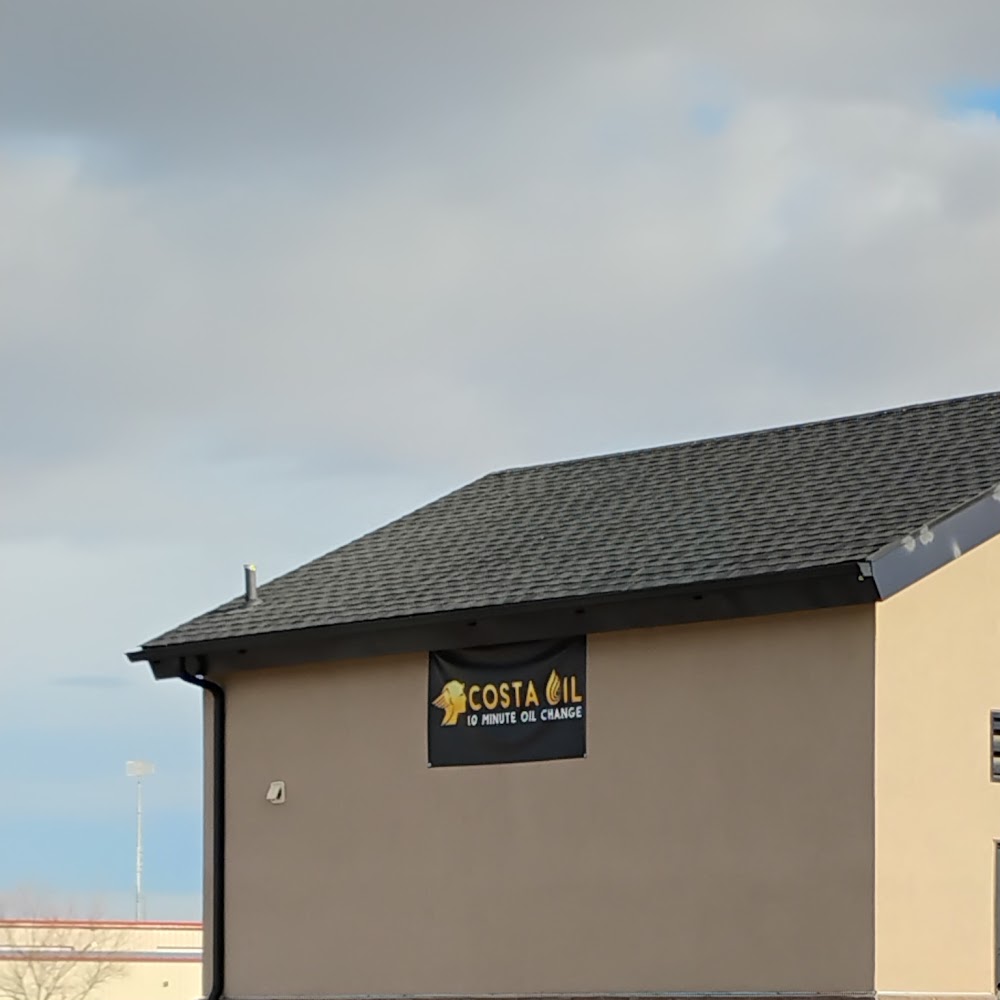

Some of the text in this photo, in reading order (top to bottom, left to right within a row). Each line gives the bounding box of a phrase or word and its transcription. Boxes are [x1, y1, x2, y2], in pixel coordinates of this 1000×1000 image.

[468, 668, 583, 711] COSTA OIL
[467, 705, 583, 726] 10 MINUTE OIL CHANGE
